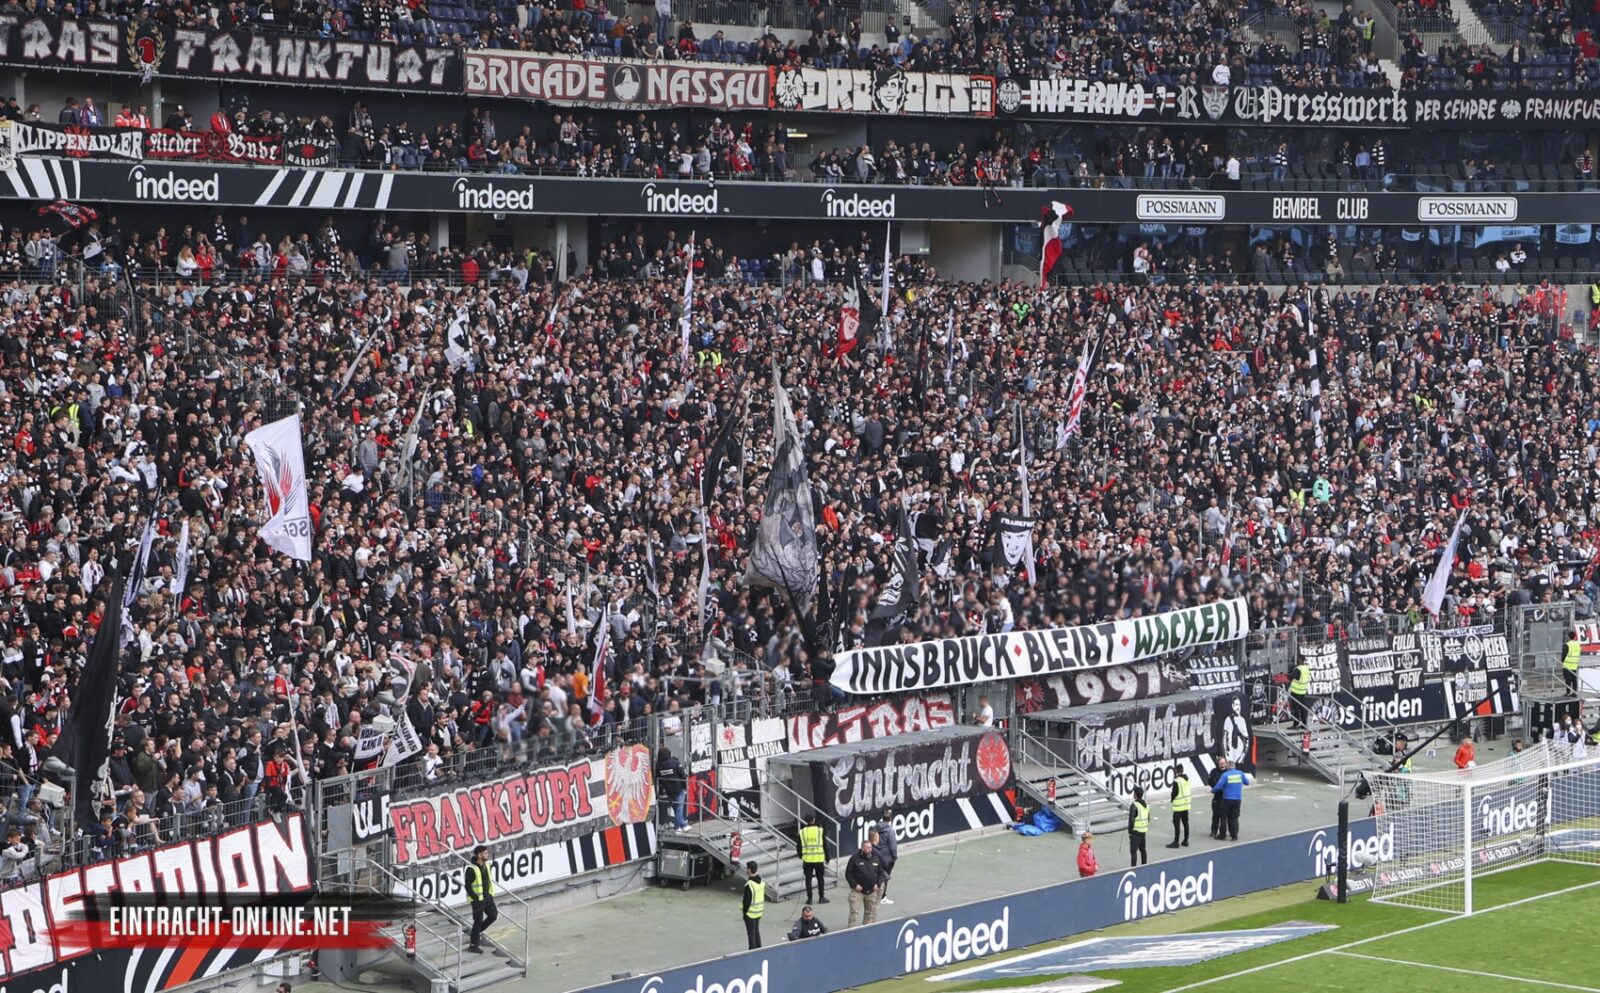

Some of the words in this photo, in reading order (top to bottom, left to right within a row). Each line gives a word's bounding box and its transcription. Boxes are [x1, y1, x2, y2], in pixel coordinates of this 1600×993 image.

[173, 29, 457, 85] FRANKFURT
[466, 54, 606, 98] BRIGADE
[646, 66, 767, 107] NASSAU
[971, 88, 991, 112] 99
[1030, 79, 1145, 116] INFERNO
[1414, 99, 1441, 122] PER
[1443, 98, 1498, 121] SEMPRE
[15, 122, 143, 160] KLIPPENADLER
[149, 131, 201, 154] Nieder
[227, 132, 278, 161] Bube
[130, 166, 219, 200] indeed
[454, 179, 534, 211] indeed
[642, 184, 718, 214] indeed
[821, 190, 896, 218] indeed
[1145, 200, 1217, 215] POSSMANN
[1272, 197, 1321, 220] BEMBEL
[1337, 197, 1369, 220] CLUB
[1428, 202, 1508, 216] POSSMANN
[849, 635, 1016, 692] INNSBRUCK
[1025, 621, 1118, 673] BLEIBT
[1132, 600, 1242, 659] WACKER!
[1482, 635, 1509, 657] RIED
[1189, 654, 1236, 669] ULTRAS
[1350, 654, 1394, 671] FRANKFURT
[1046, 662, 1162, 709] 1997
[1197, 671, 1238, 686] NEVER
[1353, 672, 1394, 689] HOOLIGANS
[1398, 670, 1422, 690] CREW
[787, 693, 956, 751] ULTRAS
[1361, 692, 1423, 722] finden
[746, 739, 785, 760] GUARDIA
[1075, 698, 1216, 772] Frankfurt
[830, 740, 973, 818] Eintracht
[390, 760, 593, 865] FRANKFURT
[855, 802, 935, 850] ineed
[490, 849, 543, 883] nden
[1119, 860, 1214, 921] indeed
[1363, 876, 1374, 888] TV
[901, 905, 1009, 972] indeed
